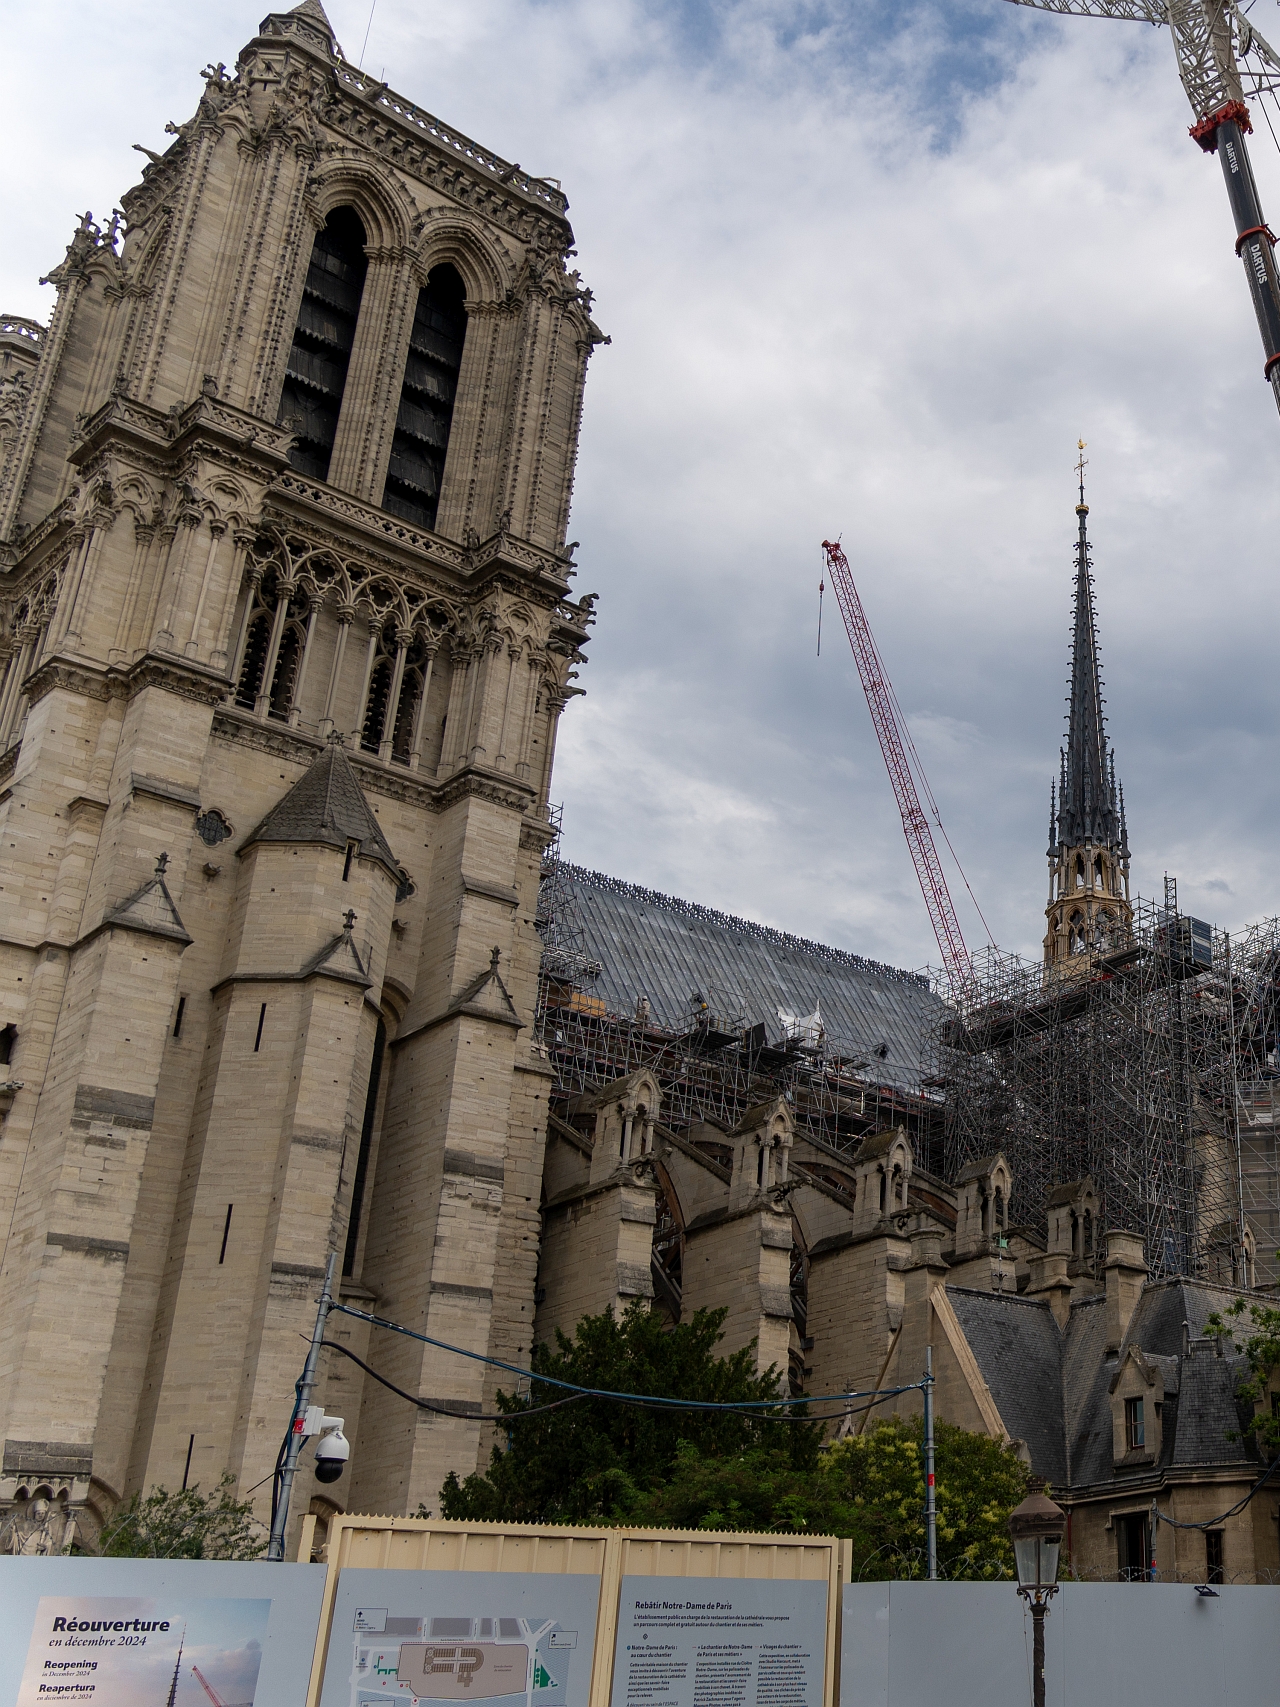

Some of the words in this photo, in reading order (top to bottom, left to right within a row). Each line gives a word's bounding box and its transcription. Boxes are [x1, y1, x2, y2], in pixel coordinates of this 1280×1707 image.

[1226, 142, 1238, 174] DARTUS
[1250, 244, 1268, 284] DARTUS
[635, 1601, 662, 1609] Rebâtir
[662, 1602, 706, 1610] Notre-Dame
[52, 1616, 170, 1632] Réouverture
[49, 1638, 62, 1647] en
[64, 1636, 116, 1647] décembre
[118, 1636, 147, 1646] 2024
[44, 1659, 98, 1670] Reopening
[38, 1684, 95, 1694] Reapertura
